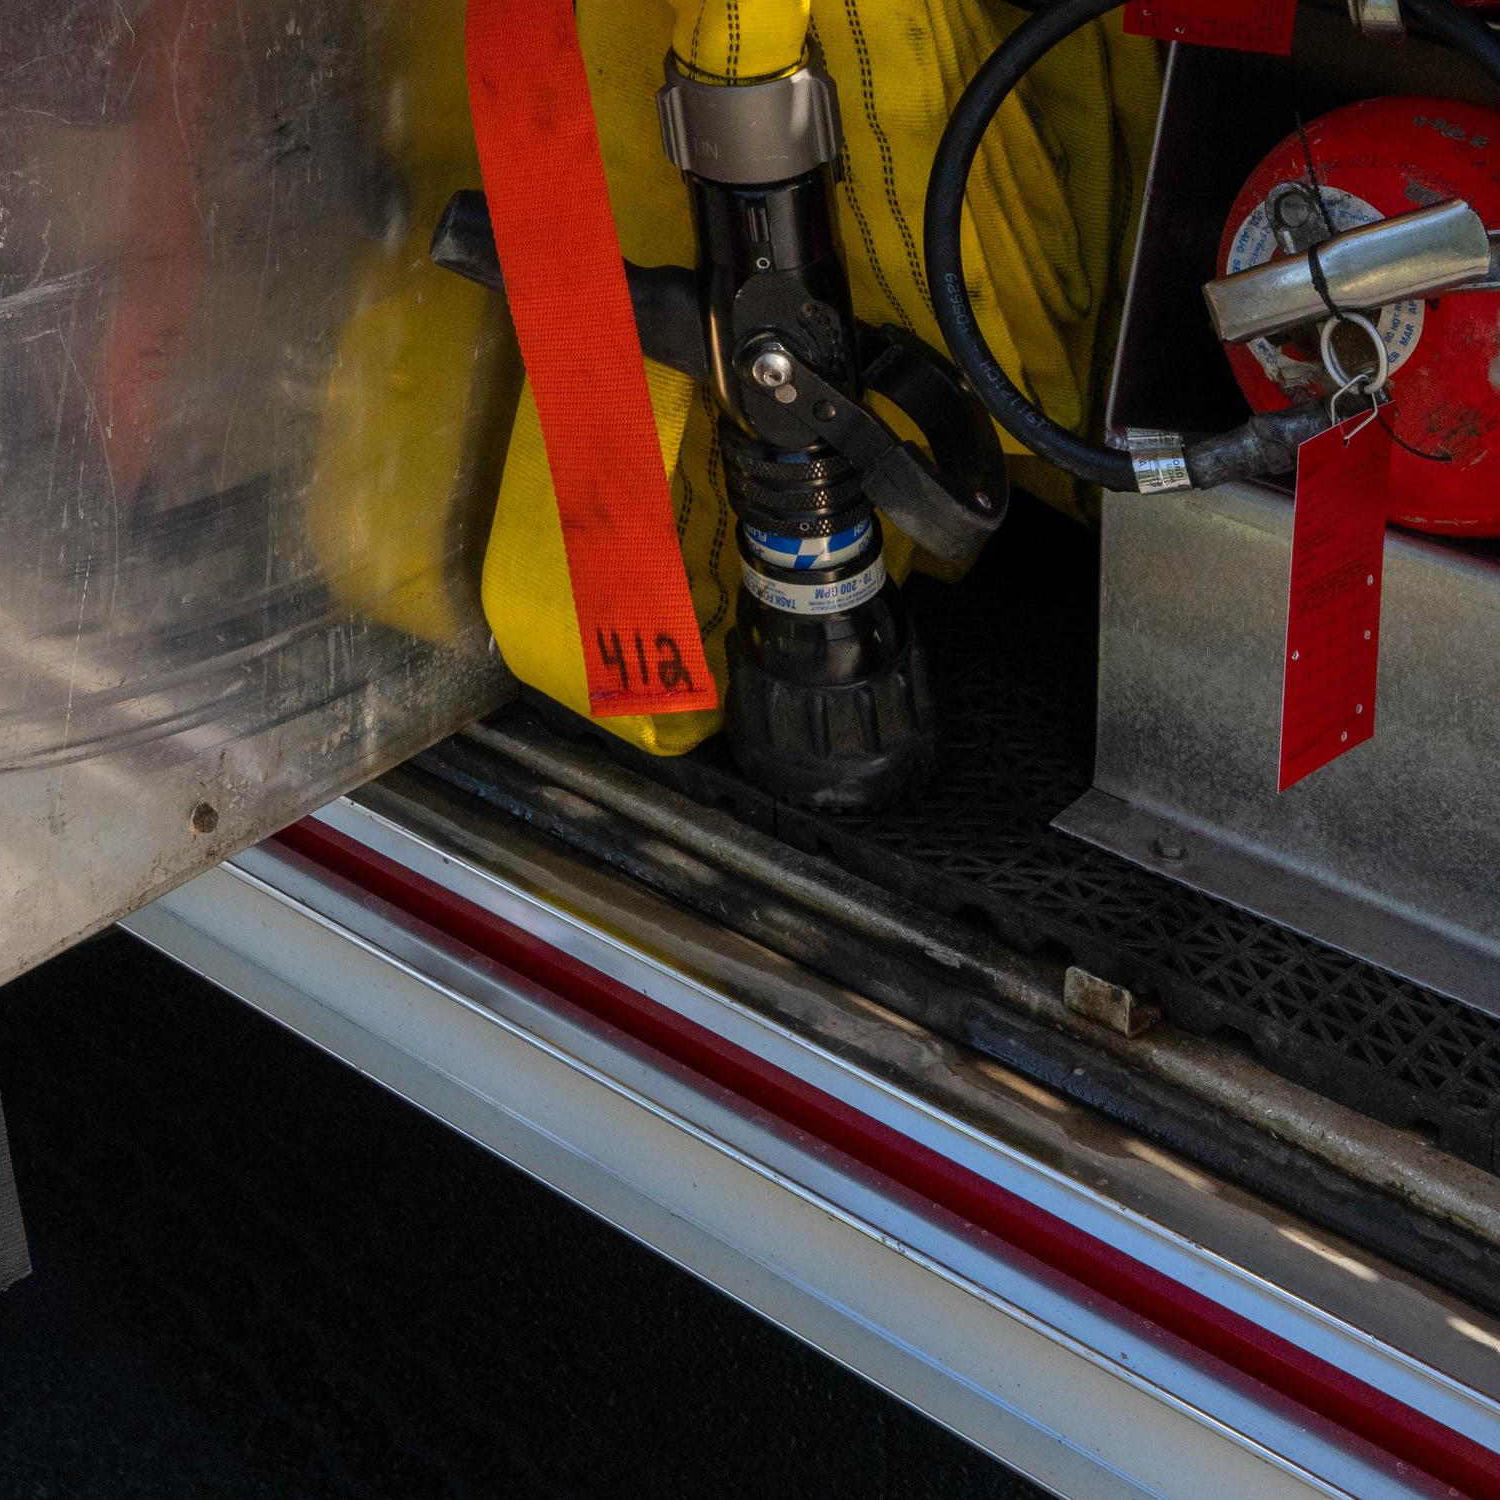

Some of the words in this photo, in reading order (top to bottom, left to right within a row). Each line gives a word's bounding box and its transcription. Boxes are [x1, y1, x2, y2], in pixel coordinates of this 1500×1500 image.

[1236, 232, 1251, 254] AUG
[1232, 259, 1243, 272] SE
[1399, 324, 1415, 347] MAR
[815, 586, 838, 599] GPM
[841, 580, 857, 594] 200
[775, 594, 797, 609] TASK
[596, 630, 694, 693] 412
